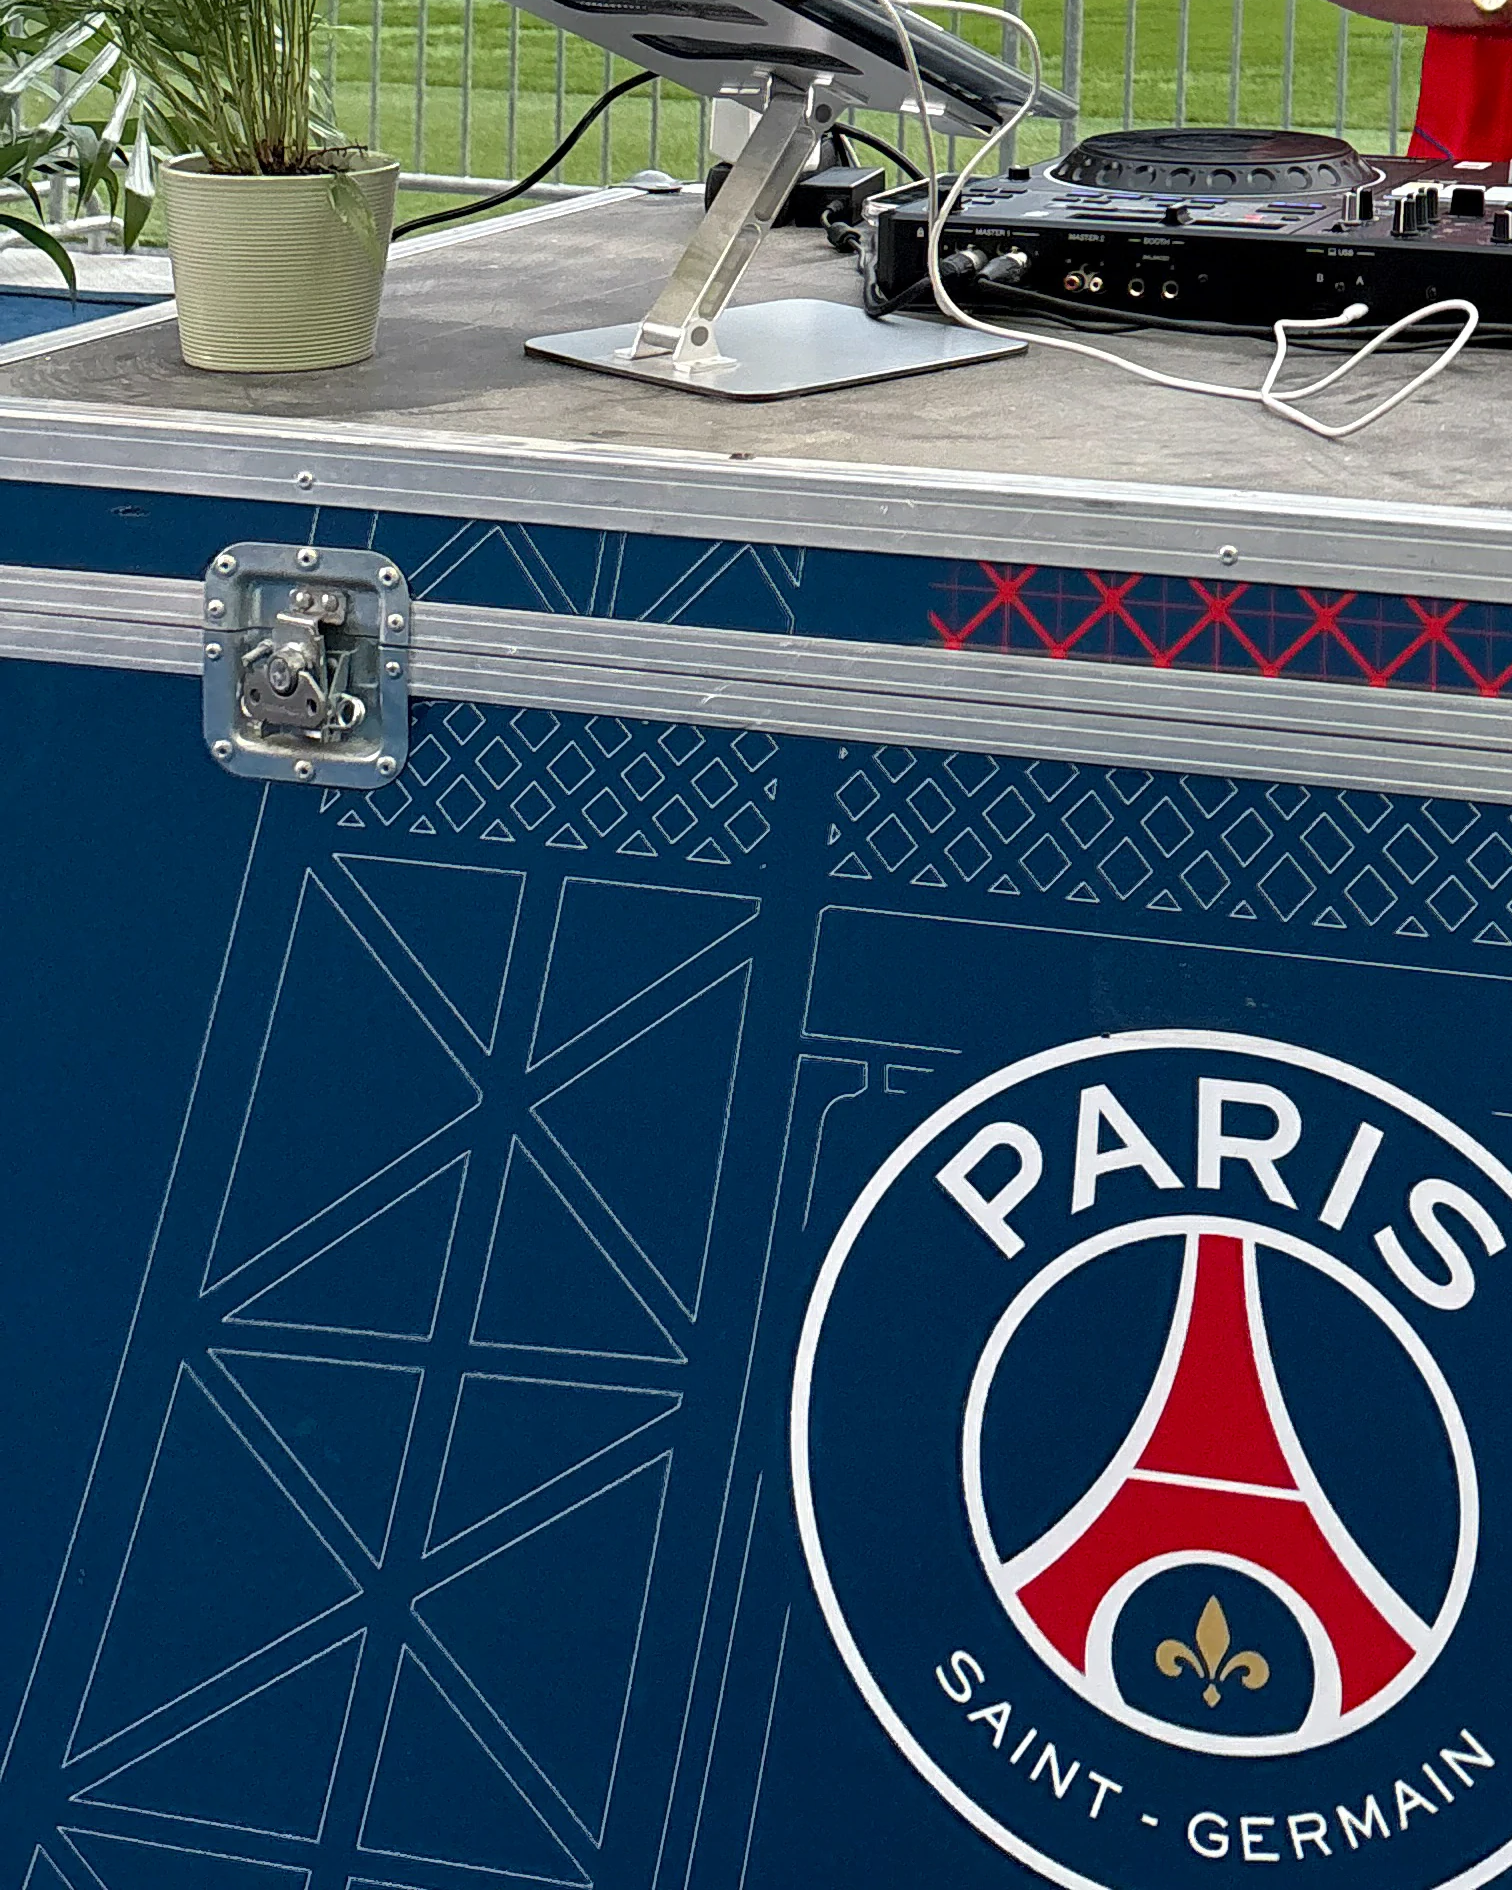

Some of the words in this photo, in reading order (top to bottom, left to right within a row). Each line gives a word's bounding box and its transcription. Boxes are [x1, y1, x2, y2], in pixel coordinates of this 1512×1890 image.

[934, 1076, 1508, 1313] PARIS
[935, 1648, 1124, 1824] SAINT
[1186, 1726, 1497, 1864] GERMAIN
